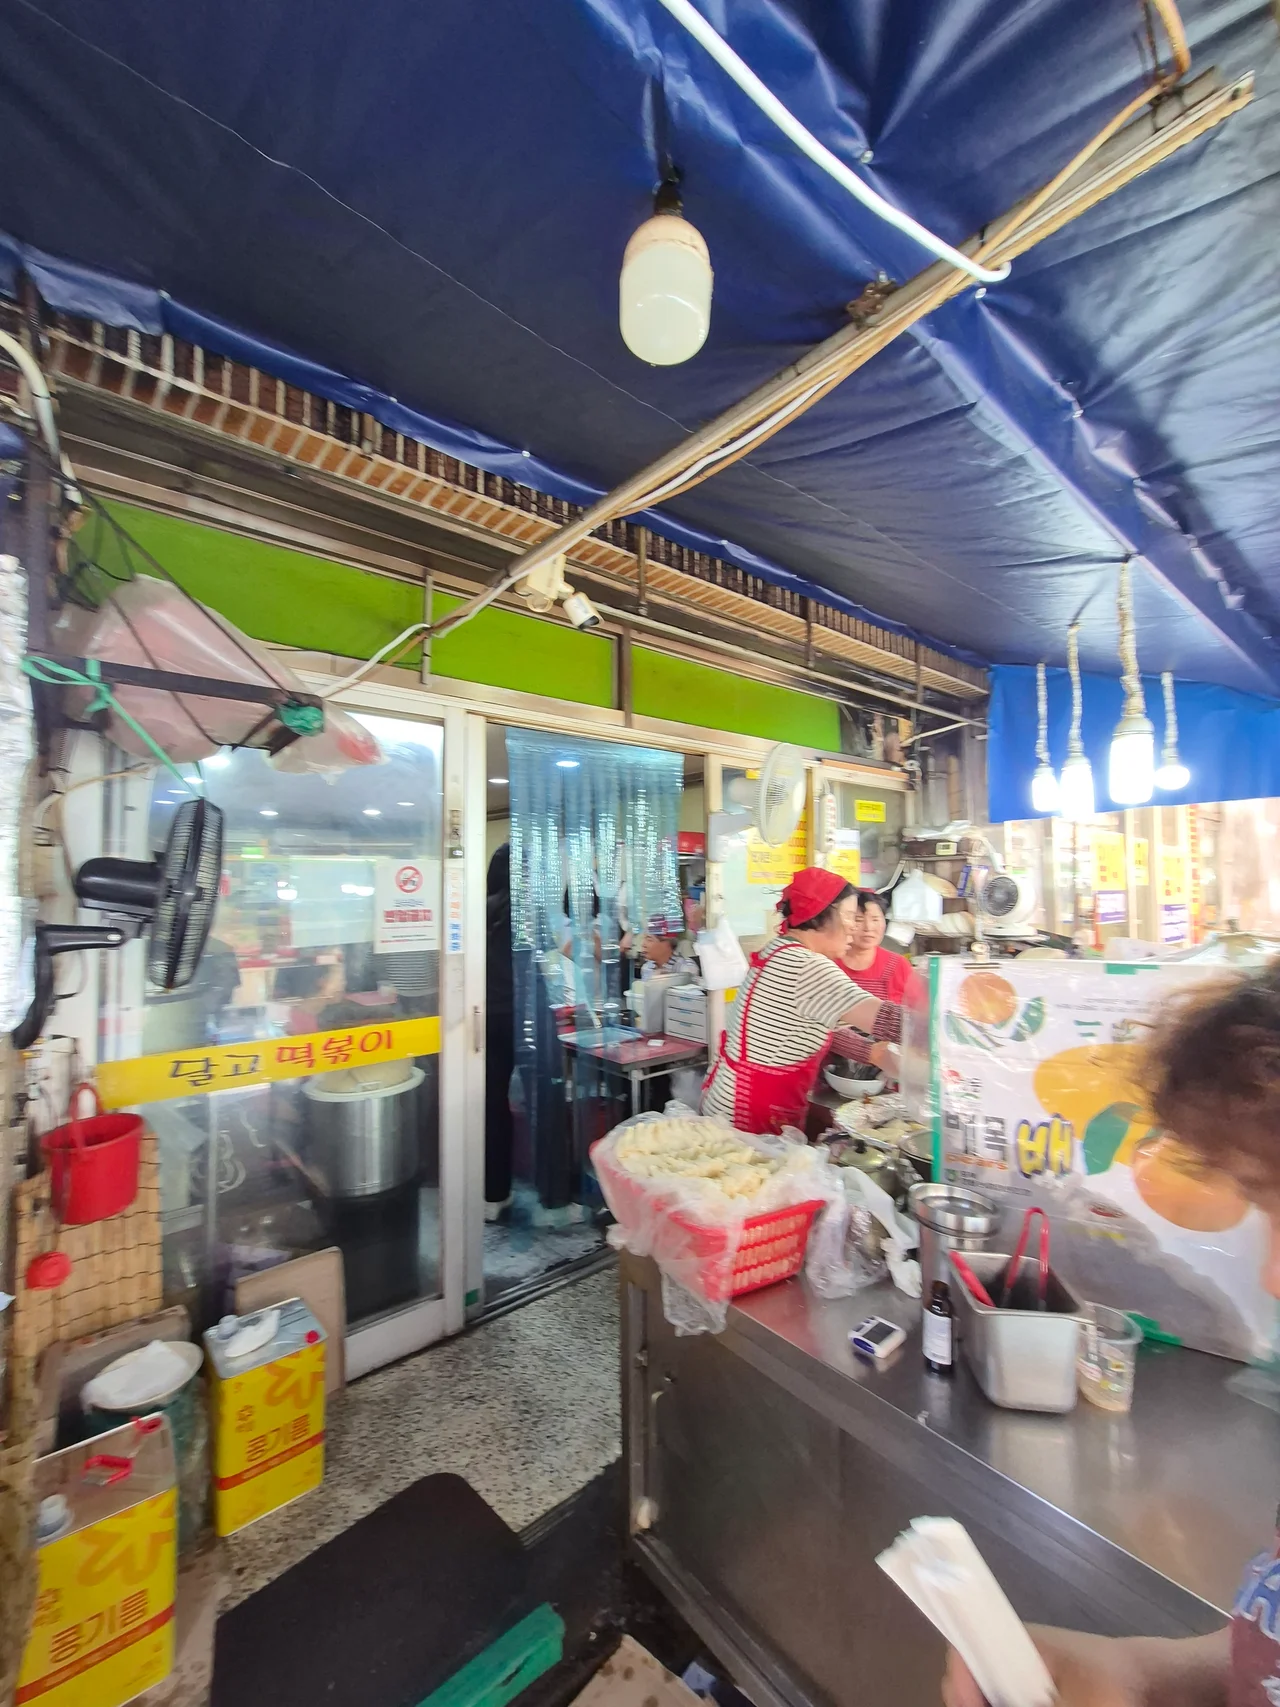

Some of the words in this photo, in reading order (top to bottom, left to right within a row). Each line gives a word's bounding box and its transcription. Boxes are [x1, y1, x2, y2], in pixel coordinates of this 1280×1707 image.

[170, 1053, 261, 1087] 달고
[275, 1029, 393, 1069] 떡볶이
[50, 1588, 148, 1664] 콩기름
